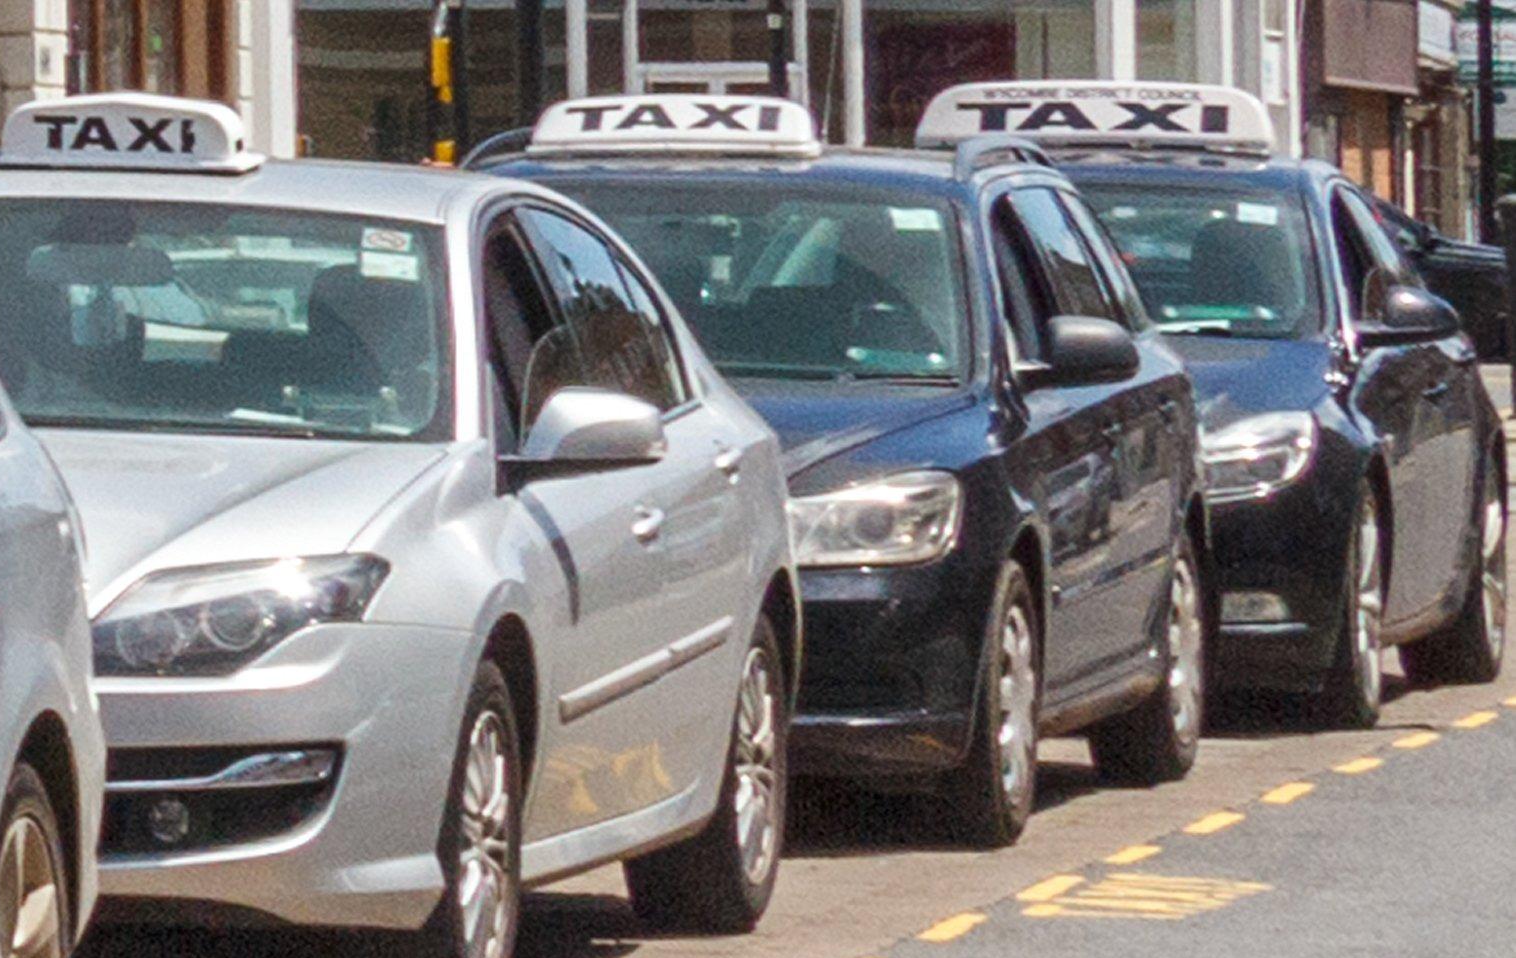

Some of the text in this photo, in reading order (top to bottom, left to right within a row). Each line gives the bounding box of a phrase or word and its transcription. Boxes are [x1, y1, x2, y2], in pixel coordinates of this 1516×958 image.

[565, 103, 781, 132] TAXI
[955, 102, 1230, 133] TAXI
[32, 114, 196, 154] TAXI
